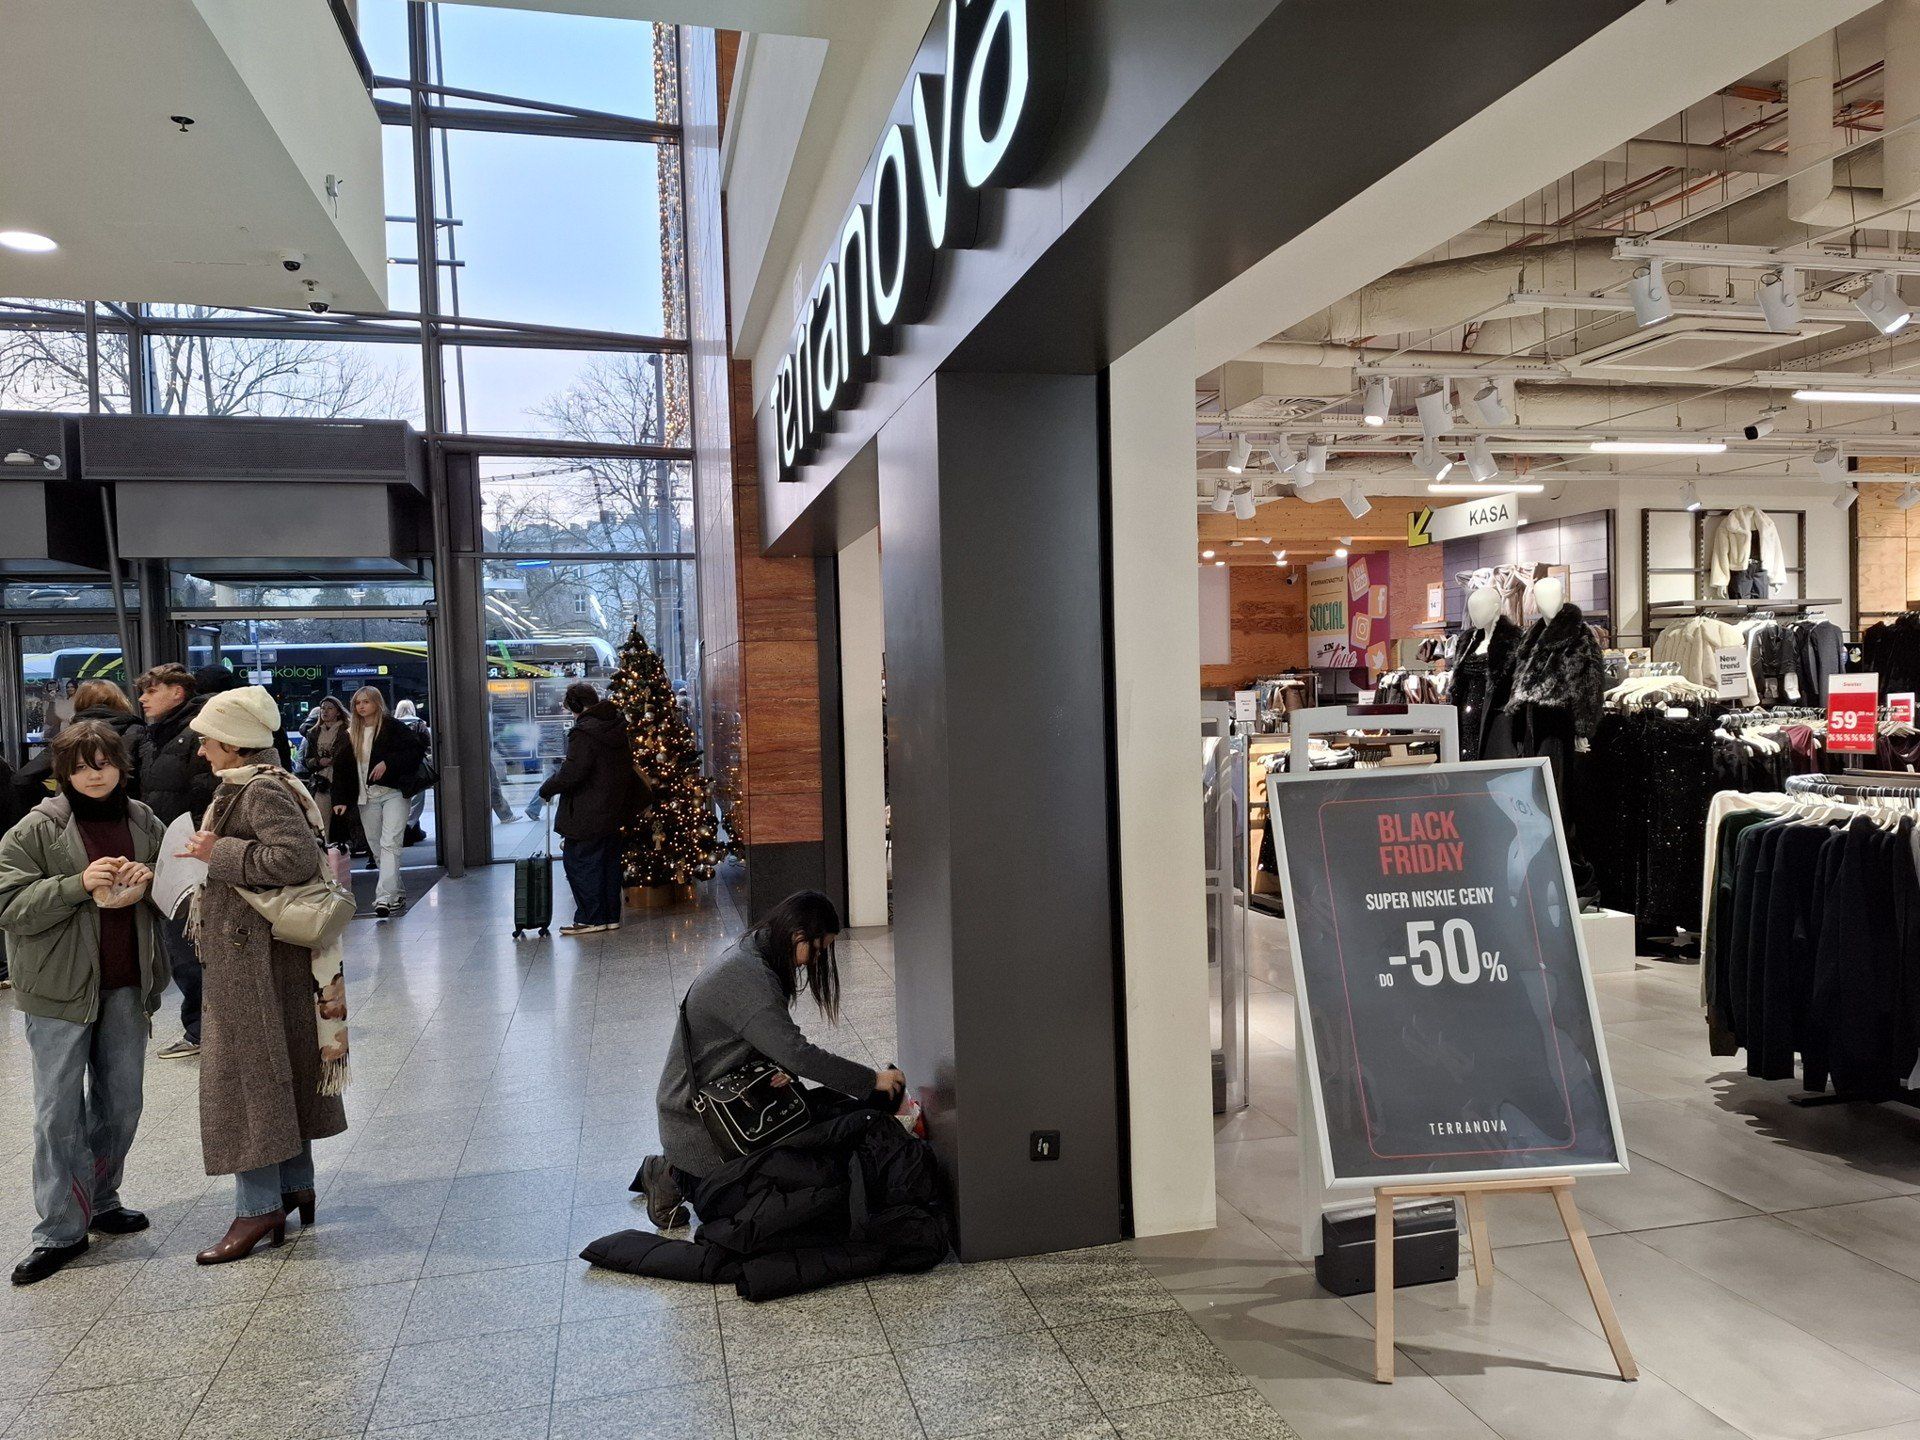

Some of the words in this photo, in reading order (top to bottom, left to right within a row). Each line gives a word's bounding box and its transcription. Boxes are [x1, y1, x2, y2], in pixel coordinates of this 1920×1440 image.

[1469, 504, 1509, 526] KASA
[1309, 600, 1346, 632] SOCIAL
[1323, 642, 1335, 651] IN
[1377, 810, 1460, 844] BLACK
[1378, 842, 1464, 876] FRIDAY
[1365, 890, 1410, 911] SUPER
[1411, 888, 1457, 909] NISKIE
[1458, 886, 1494, 906] CENY
[1379, 972, 1394, 987] DO
[1388, 917, 1508, 987] -50%
[1428, 1119, 1508, 1136] TERRANOVA
